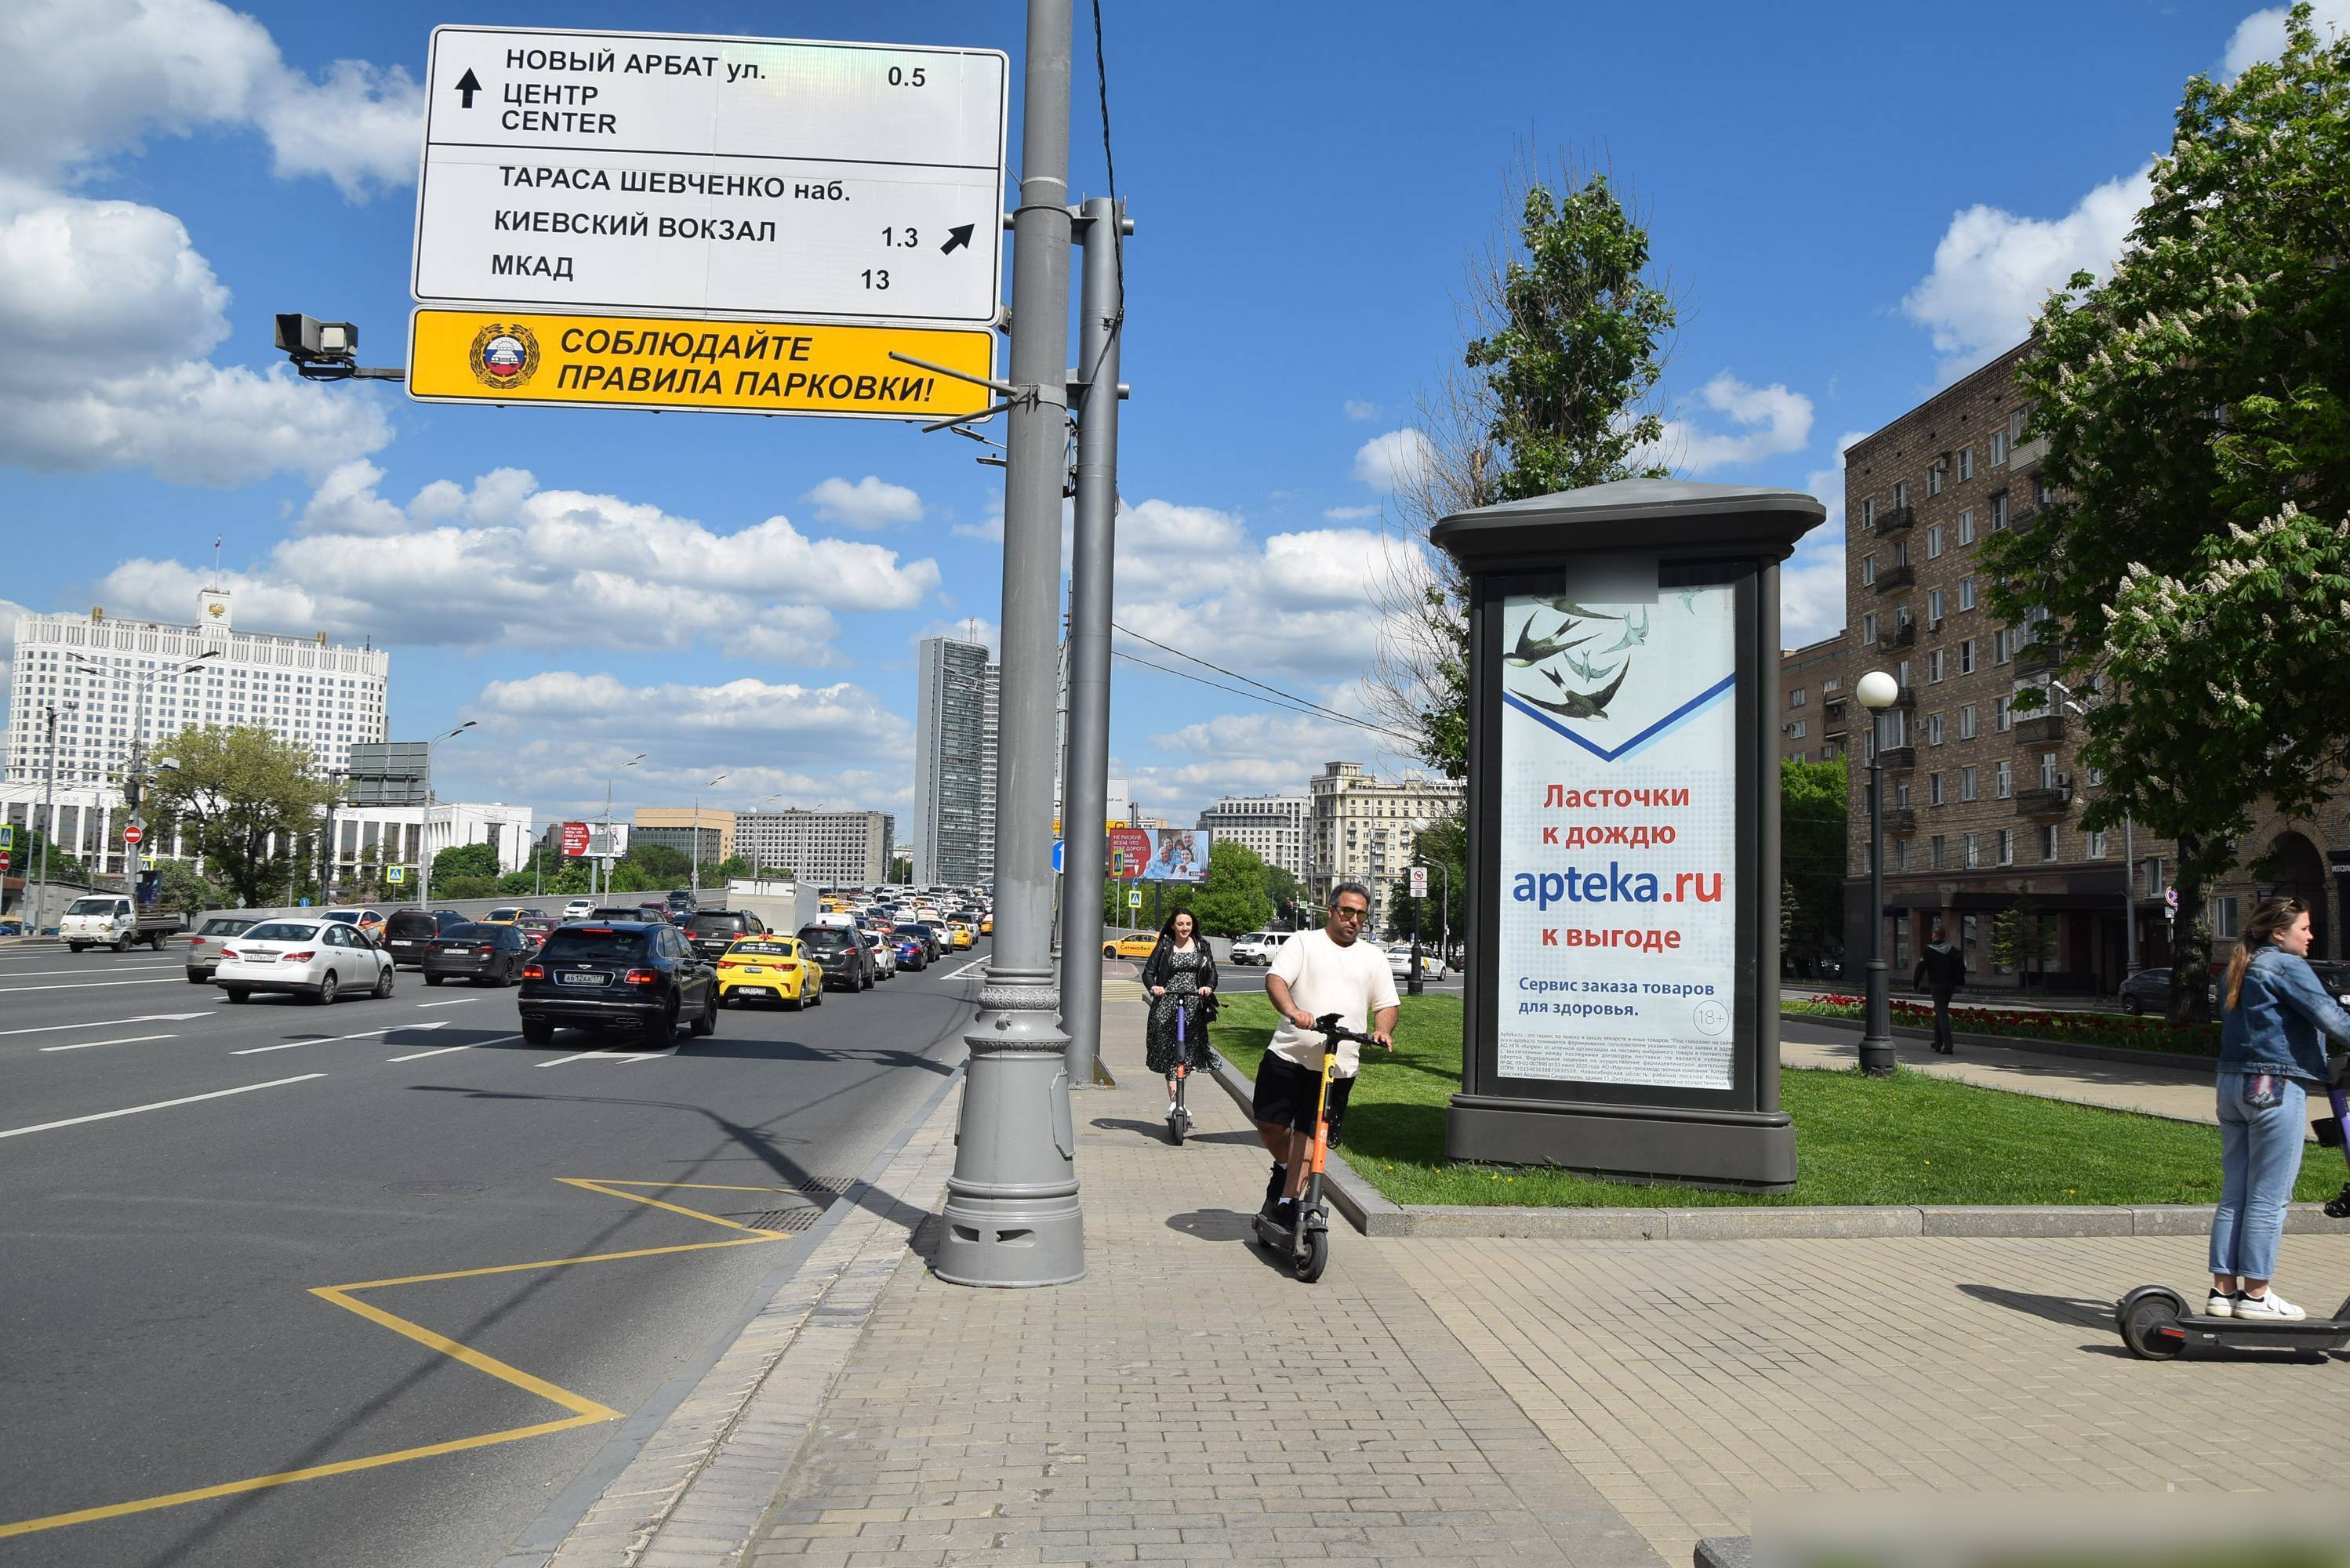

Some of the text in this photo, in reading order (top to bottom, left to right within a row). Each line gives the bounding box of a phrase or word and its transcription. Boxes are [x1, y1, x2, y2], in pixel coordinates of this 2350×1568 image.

[507, 49, 765, 82] НОВЫЙ АРБАТ ул.
[888, 67, 924, 86] 0.5
[504, 84, 597, 107] ЦЕНТР
[503, 111, 616, 133] CENTER
[499, 166, 849, 201] ТАРАСА ШЕВЧЕНКО наб.
[496, 211, 775, 241] КИЕВСКИЙ ВОКЗАЛ
[882, 227, 917, 247] 1.3
[492, 255, 572, 281] МКАД
[862, 270, 889, 289] 13
[561, 329, 812, 363] СОБЛЮДАЙТЕ
[558, 365, 935, 402] ПРАВИЛА ПАРКОВКИ!
[1545, 785, 1688, 807] Ласточки
[1544, 826, 1676, 848] к дождю
[1513, 862, 1721, 911] apteka.ru
[1543, 929, 1680, 953] к выгоде
[1519, 977, 1715, 998] Сервис заказа товаров
[1518, 1001, 1639, 1018] для здоровья.
[1699, 1010, 1724, 1025] 18+
